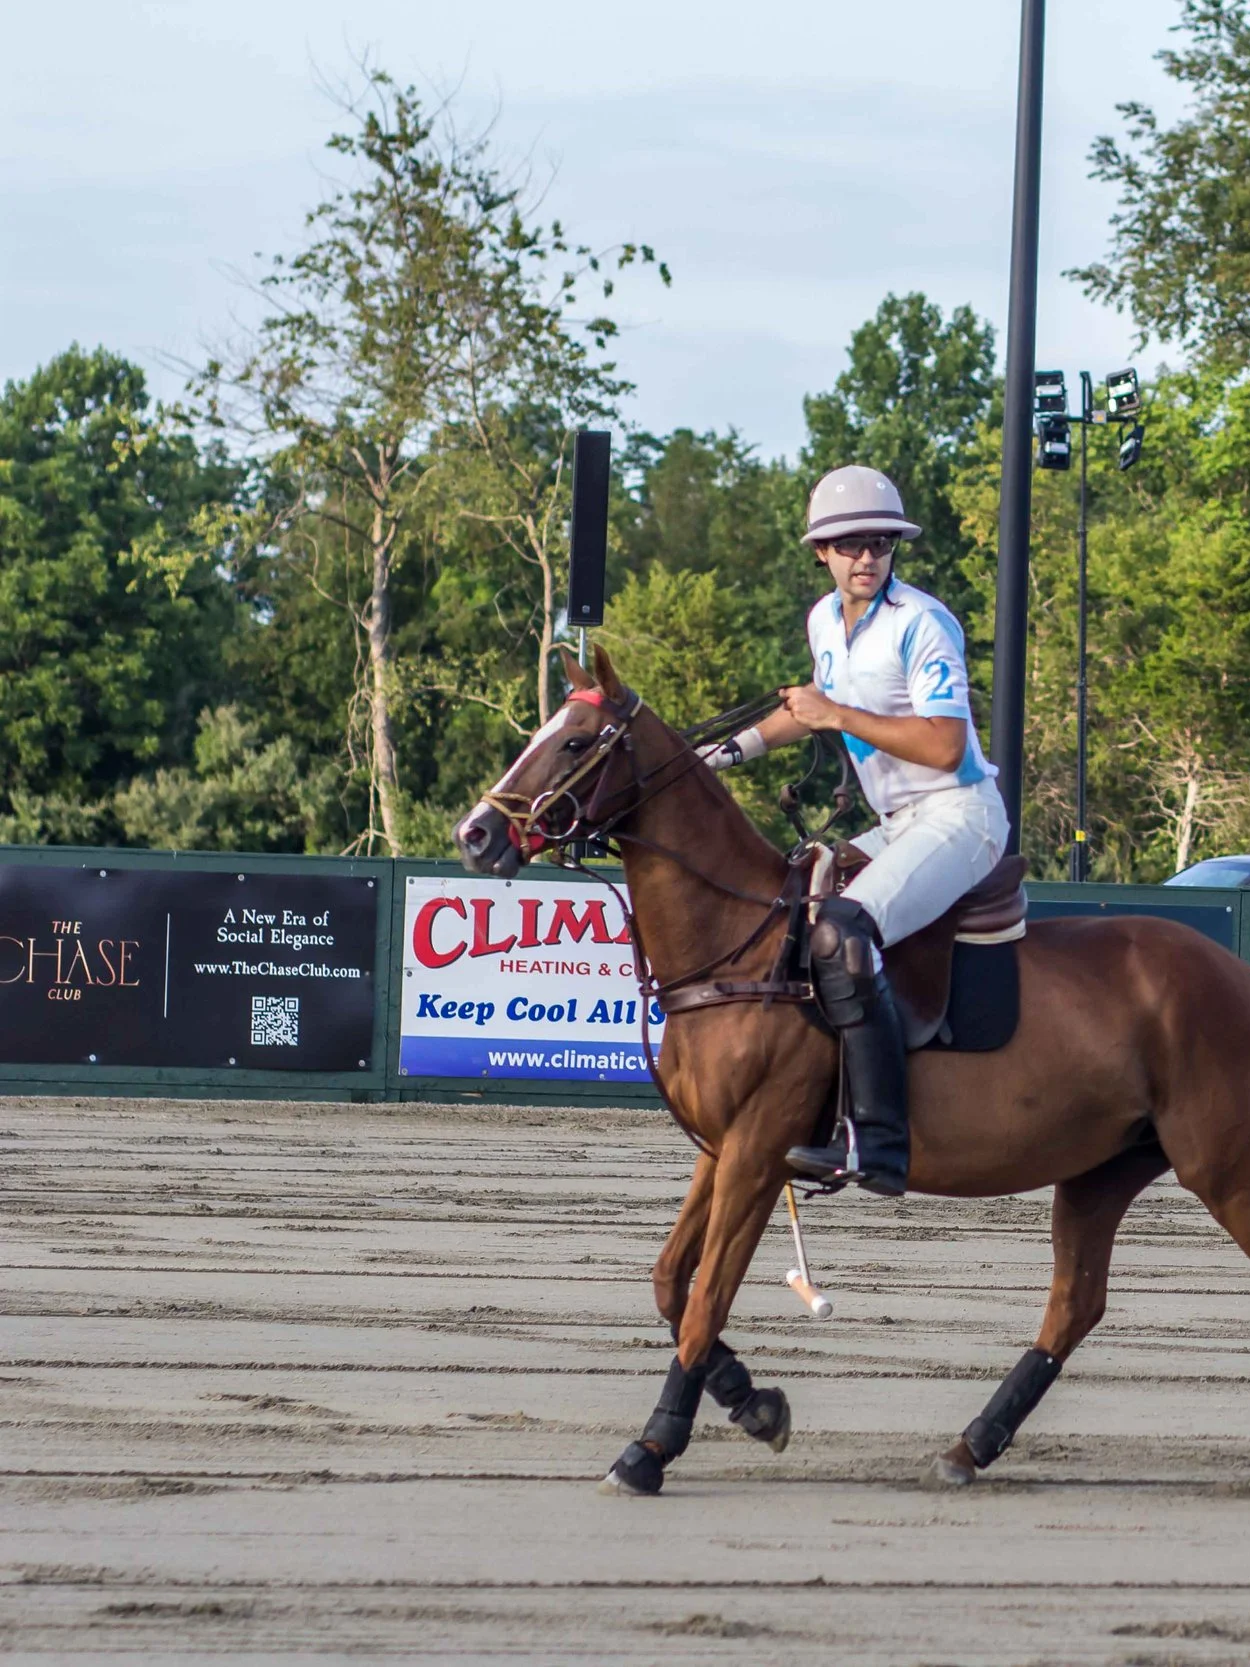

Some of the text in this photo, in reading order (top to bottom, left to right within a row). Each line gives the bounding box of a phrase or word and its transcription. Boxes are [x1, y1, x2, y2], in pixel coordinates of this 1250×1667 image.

[820, 650, 834, 690] 2
[924, 657, 954, 701] 2
[51, 920, 83, 934] THE
[223, 908, 330, 927] A New Era of
[216, 927, 335, 951] Social Elegance
[193, 961, 361, 979] www.TheChaseClub.com
[500, 959, 633, 977] HEATING & C
[47, 988, 82, 1001] CLUB
[416, 993, 496, 1026] Keep
[506, 996, 578, 1023] Cool
[586, 998, 637, 1025] All
